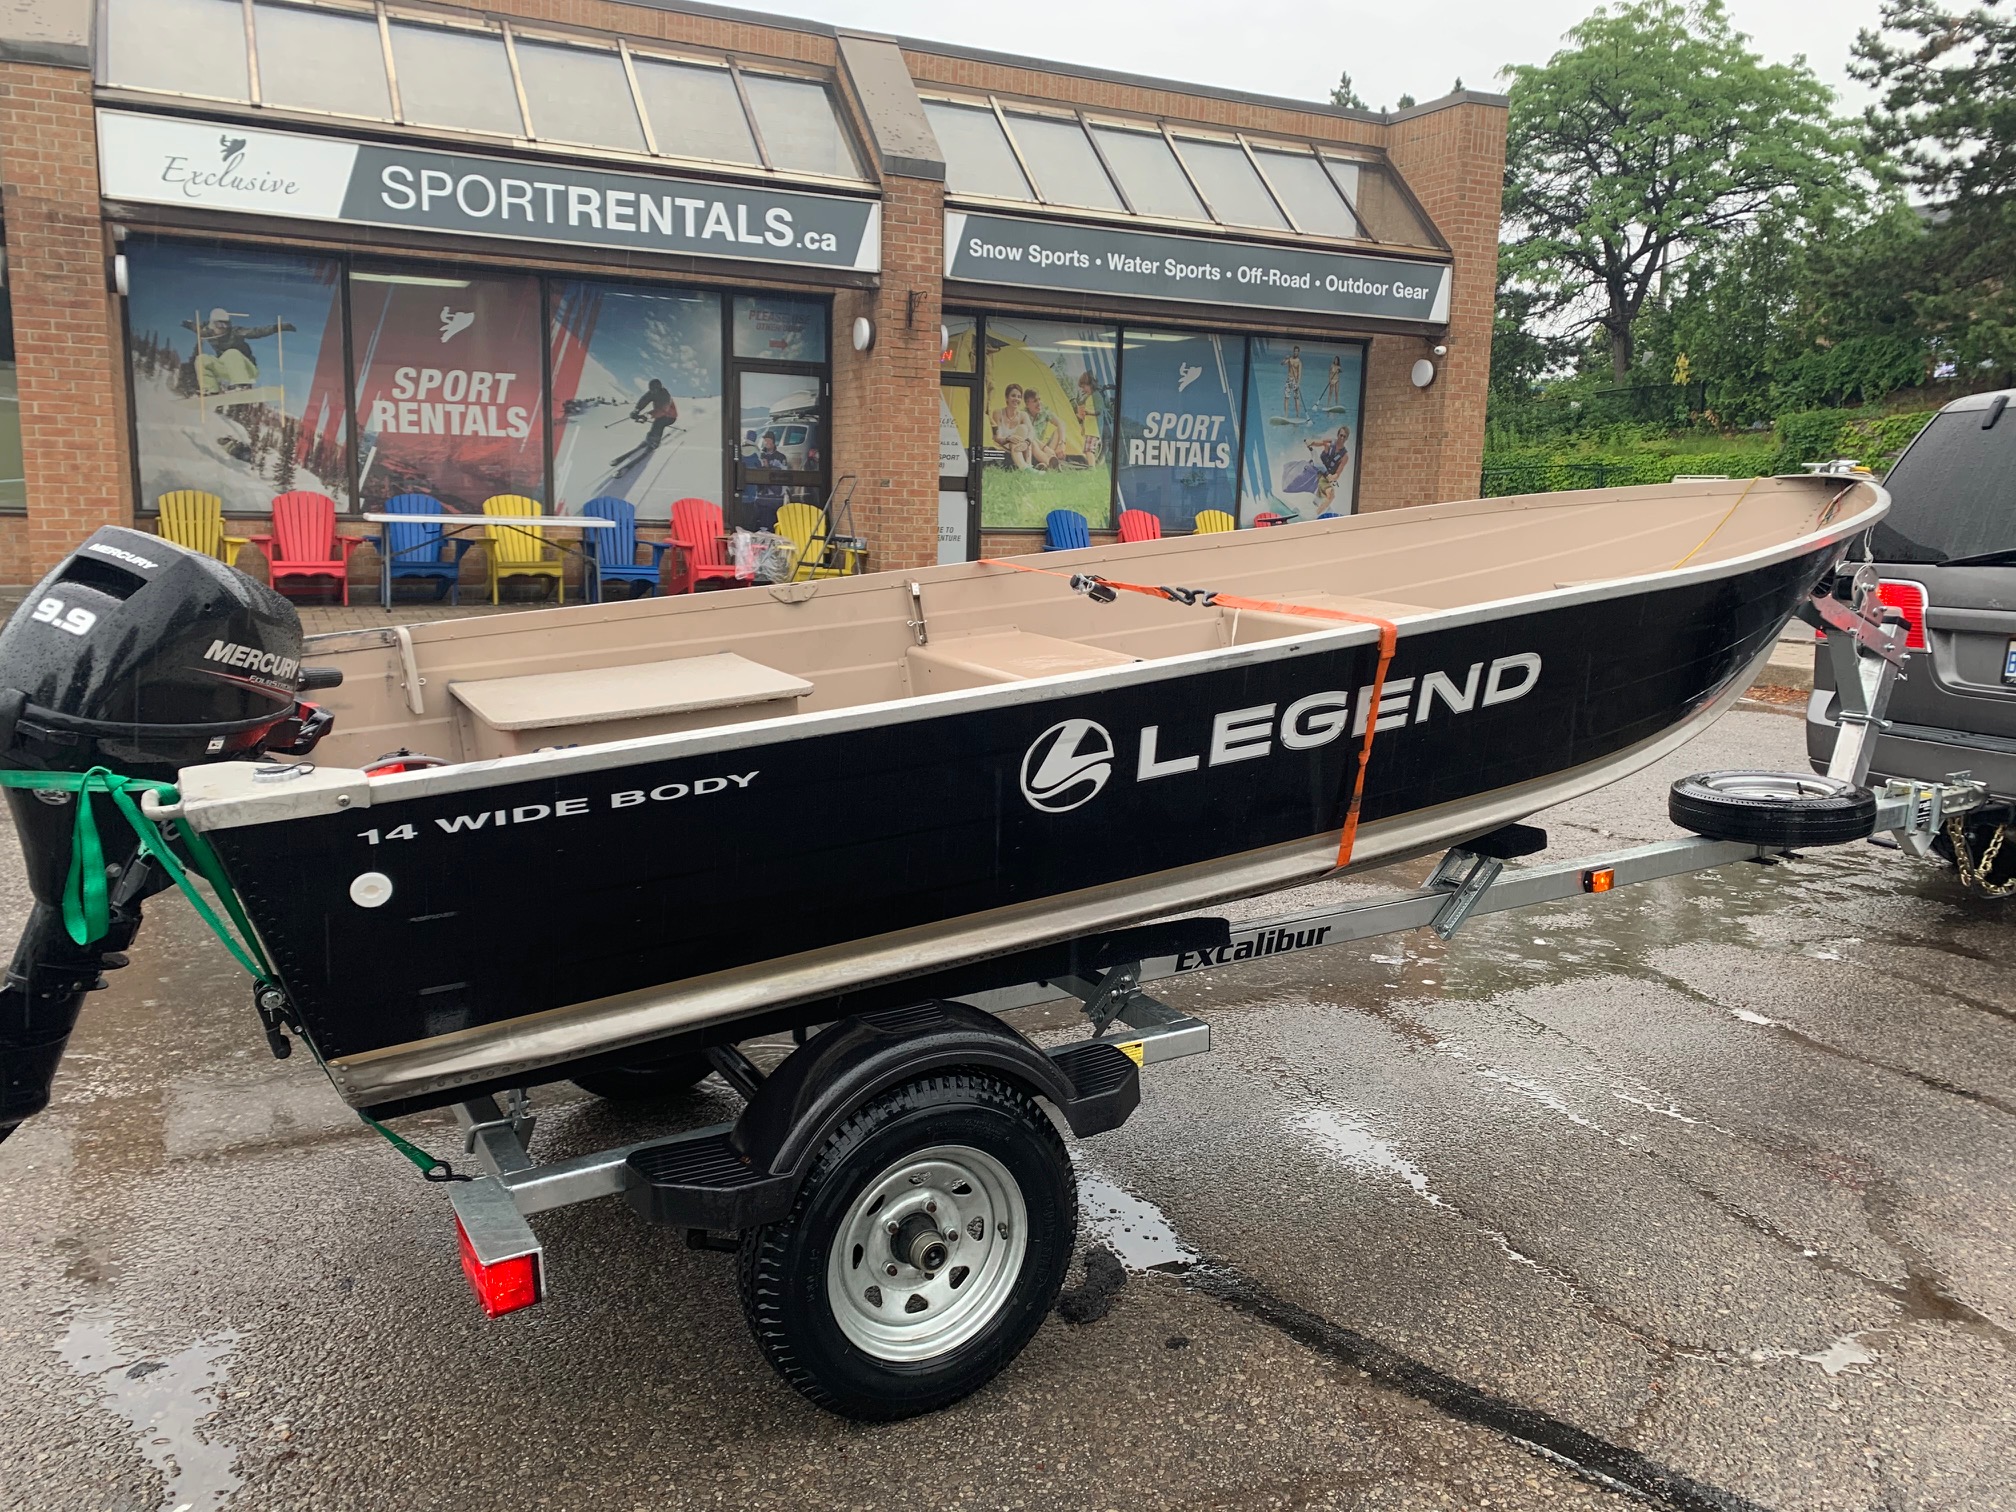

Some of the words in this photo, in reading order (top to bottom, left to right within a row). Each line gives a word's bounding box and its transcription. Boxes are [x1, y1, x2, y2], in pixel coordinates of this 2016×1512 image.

[161, 148, 299, 197] Exclusive
[380, 164, 838, 254] SPORTRENTALS.ca
[968, 237, 1022, 262] Snow
[1028, 243, 1090, 269] Sports
[1106, 252, 1161, 275] Water
[1164, 258, 1222, 282] Sports
[1237, 265, 1311, 290] Off-Road
[1325, 274, 1389, 297] Outdoor
[1393, 280, 1430, 301] Gear
[392, 366, 516, 403] SPORT
[371, 398, 530, 440] RENTALS
[1143, 410, 1226, 442] SPORT
[1128, 437, 1231, 469] RENTALS
[88, 542, 159, 570] MERCURY
[31, 596, 97, 637] 9.9
[203, 639, 300, 680] MERCURY
[1136, 650, 1545, 784] LEGEND
[358, 820, 420, 847] 14
[434, 796, 590, 836] WIDE
[610, 769, 760, 808] BODY
[1174, 925, 1332, 973] Excalibur
